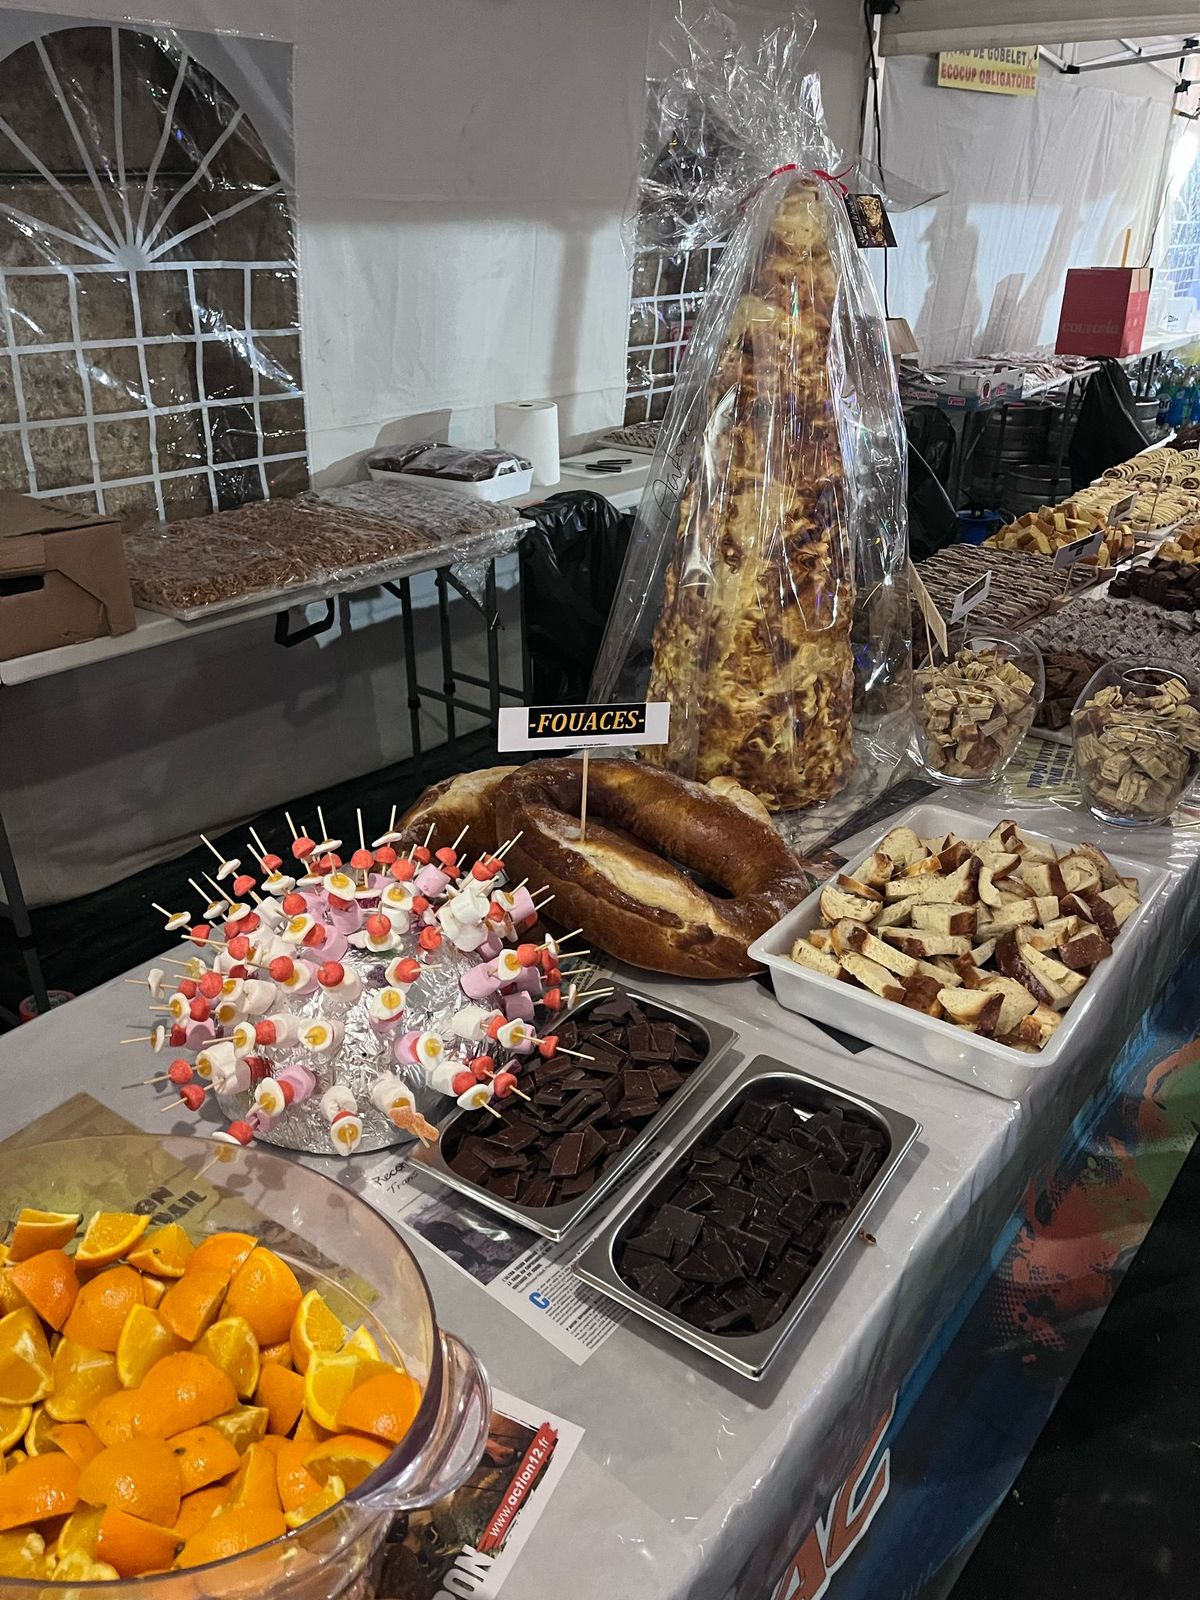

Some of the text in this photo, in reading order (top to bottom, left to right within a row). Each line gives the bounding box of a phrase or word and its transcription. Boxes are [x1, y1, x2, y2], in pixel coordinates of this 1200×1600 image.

[987, 48, 1027, 66] GOBELET
[941, 63, 1036, 90] ECOCUP OBLIGATOIRE
[489, 1436, 549, 1537] www.action12.fr
